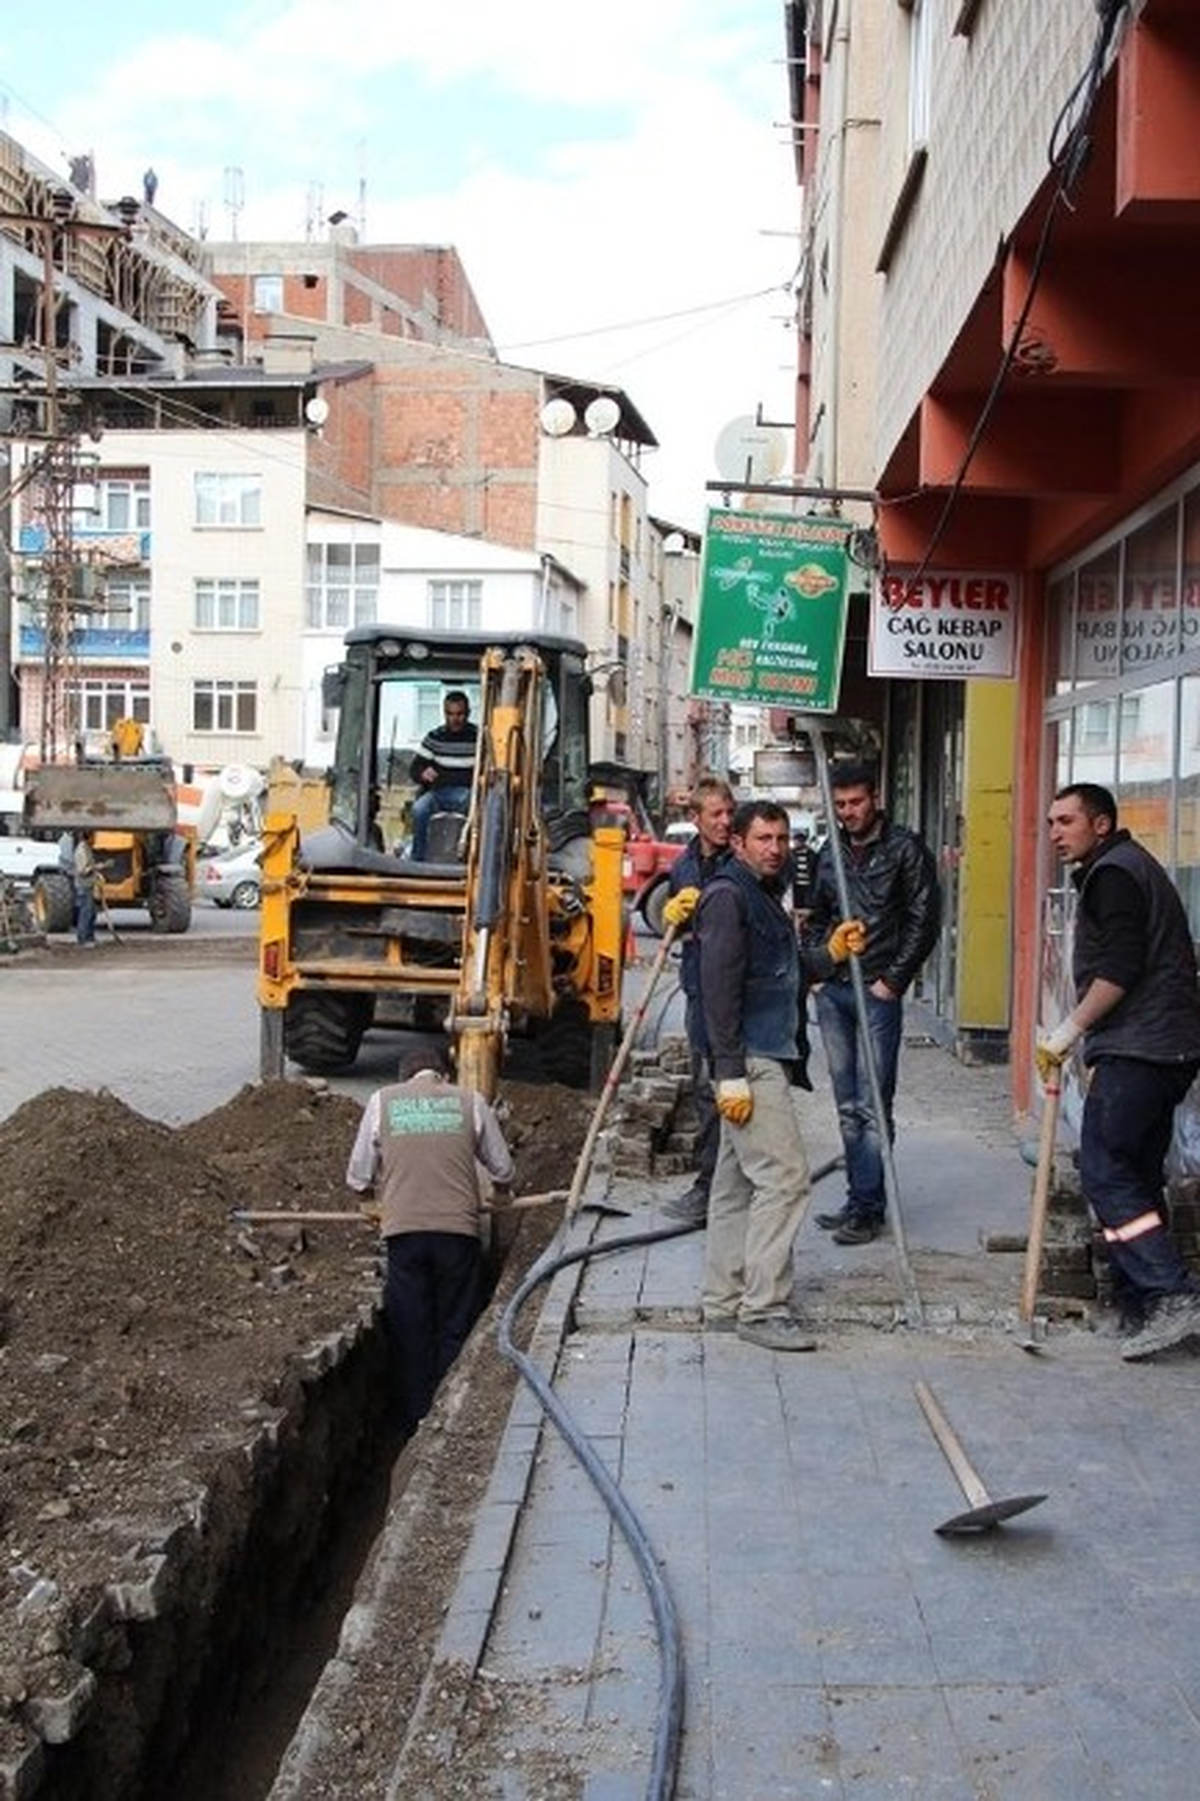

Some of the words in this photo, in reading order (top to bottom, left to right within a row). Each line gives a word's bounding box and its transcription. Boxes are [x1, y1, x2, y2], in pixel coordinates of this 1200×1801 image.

[881, 576, 1009, 612] BEYLER
[937, 618, 1002, 638] KEBAP
[903, 640, 984, 661] SALONU
